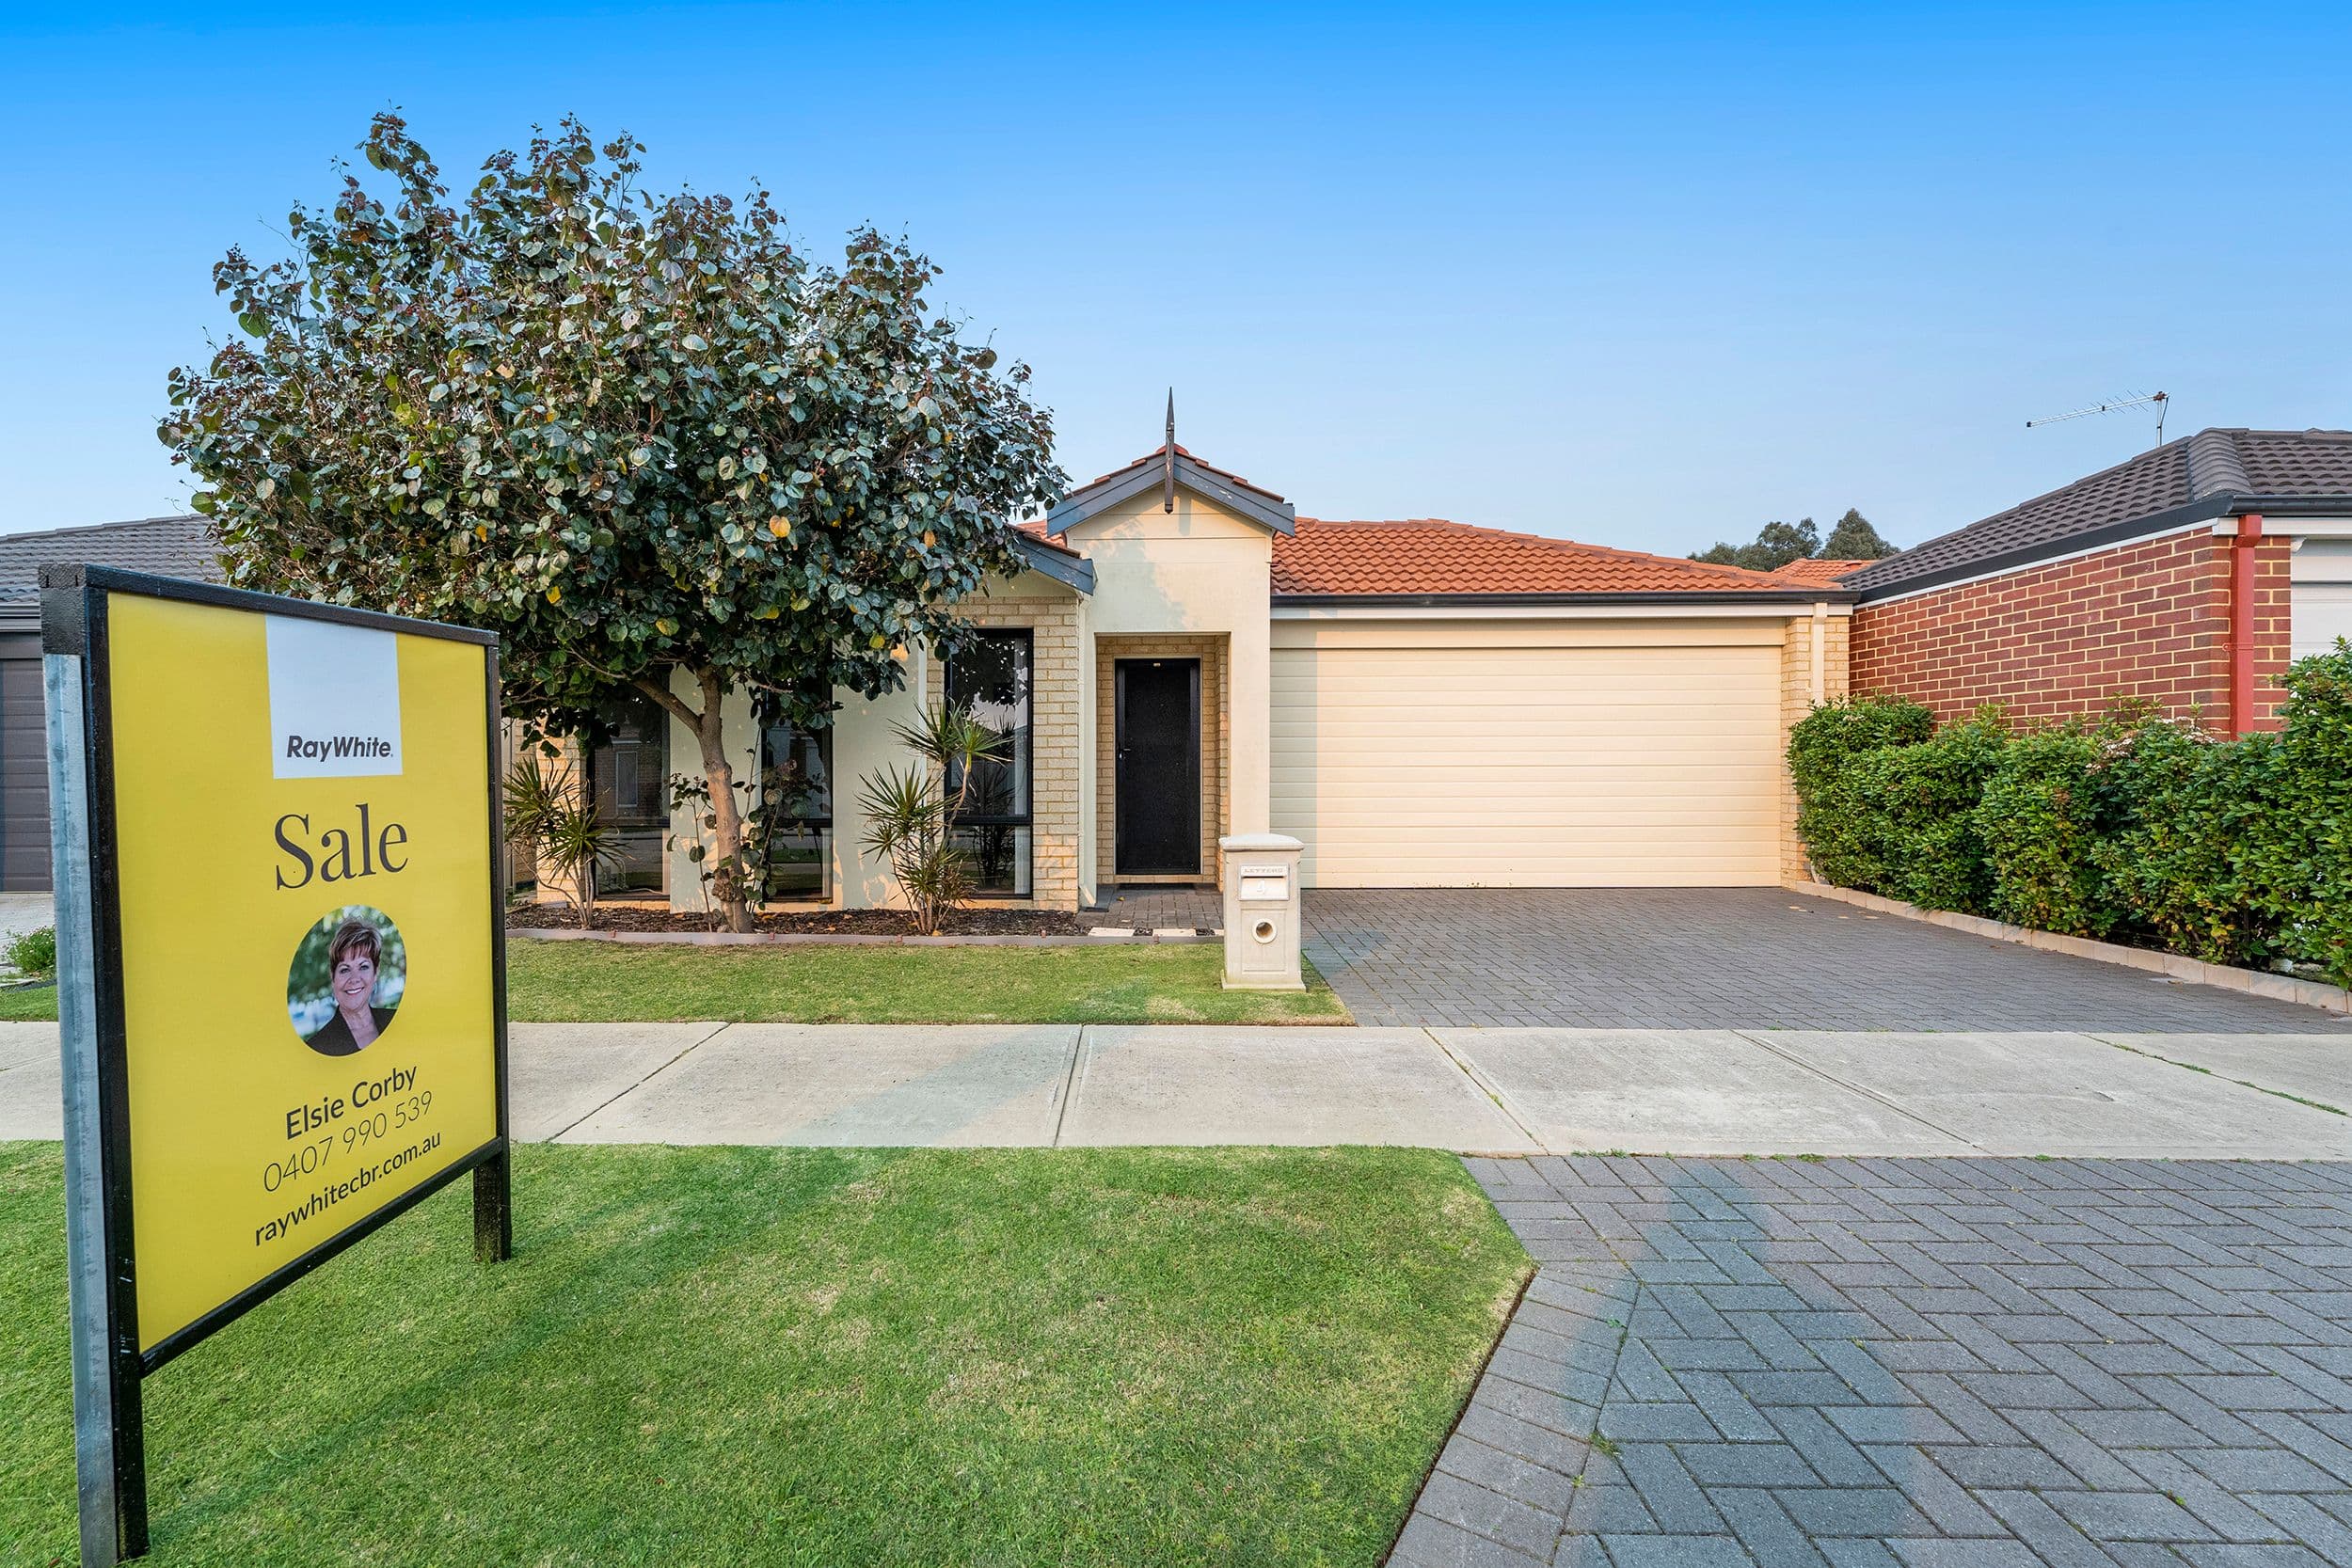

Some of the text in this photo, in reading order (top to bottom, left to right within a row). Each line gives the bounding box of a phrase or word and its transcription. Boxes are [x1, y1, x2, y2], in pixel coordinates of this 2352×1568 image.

[274, 803, 408, 890] Sale
[263, 1090, 433, 1192] 0407 990 539
[286, 1066, 417, 1140] Elsie Corby
[255, 1132, 441, 1246] raywhitecbr.com.au
